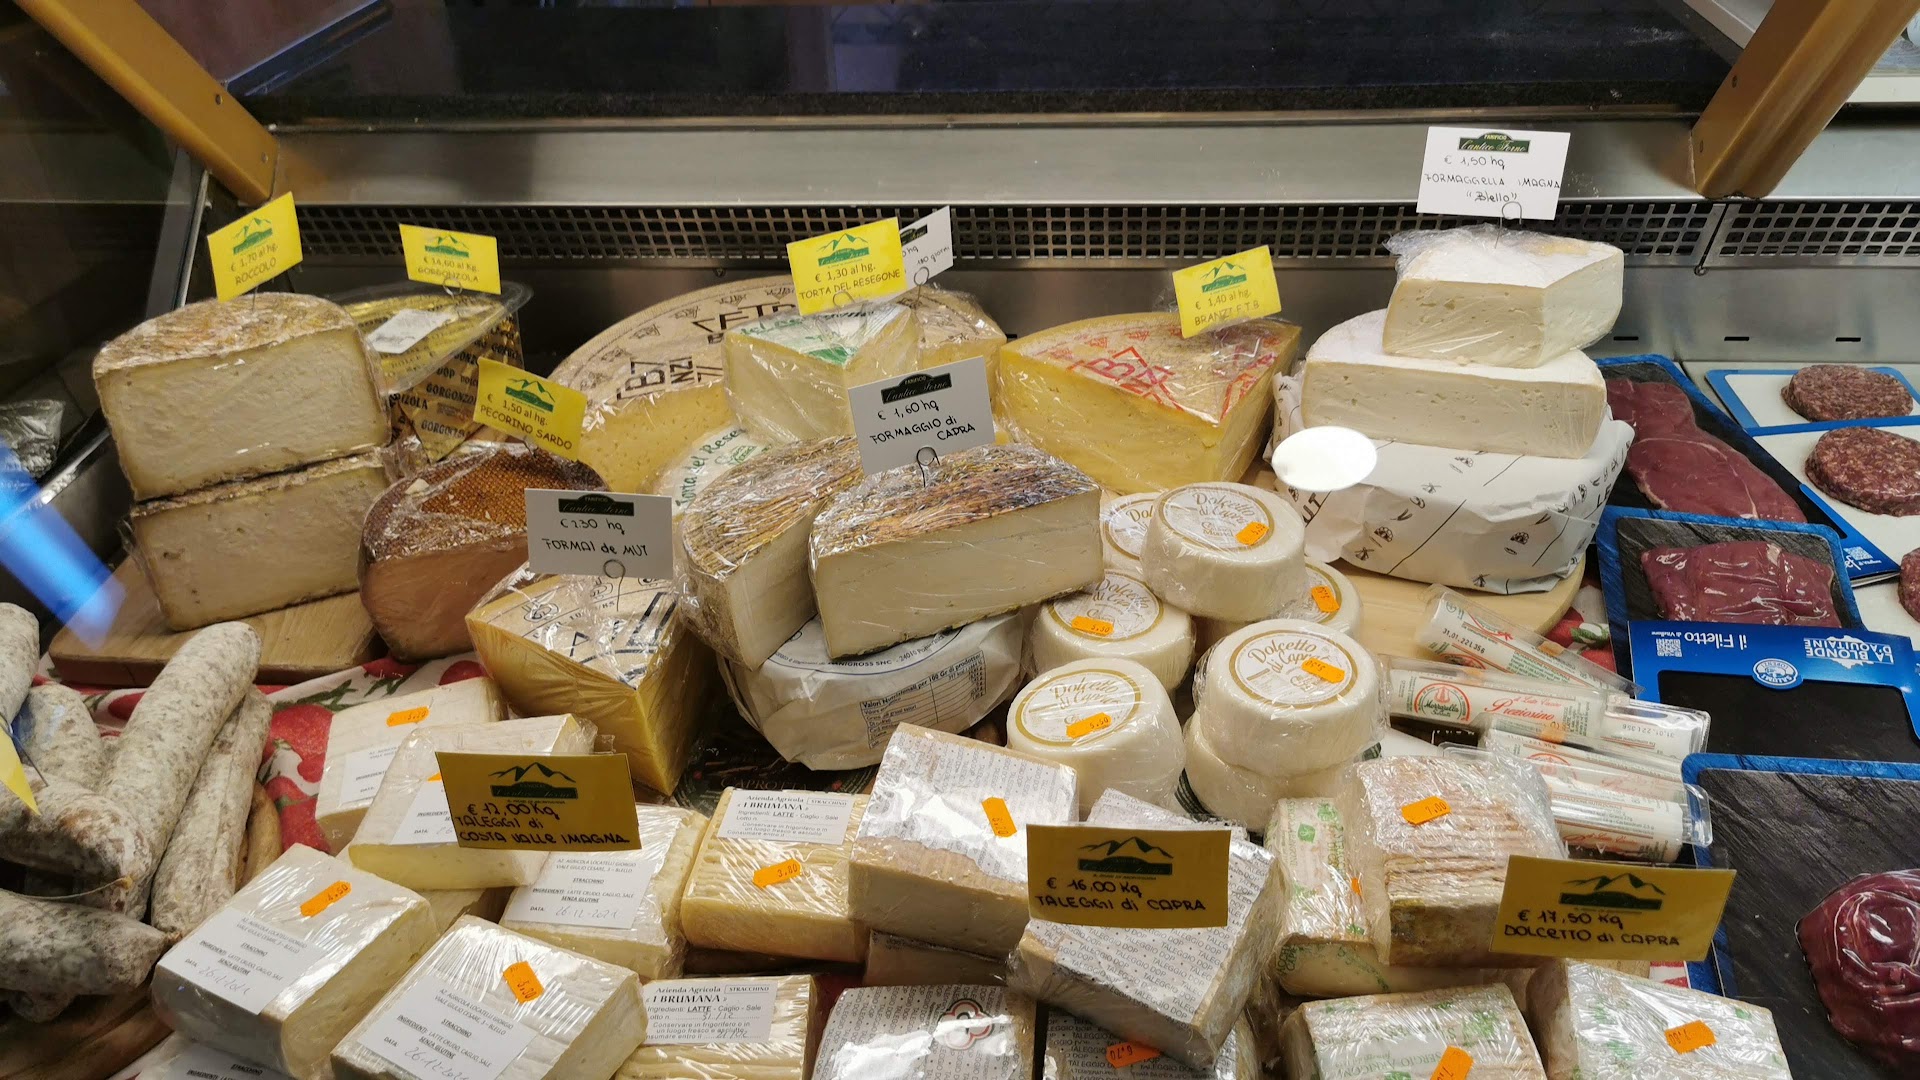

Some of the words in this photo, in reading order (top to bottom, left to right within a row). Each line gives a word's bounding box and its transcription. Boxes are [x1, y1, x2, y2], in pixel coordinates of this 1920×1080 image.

[1460, 156, 1487, 167] 1,50
[235, 257, 276, 286] ROCCOLO
[815, 274, 822, 283] €
[828, 269, 848, 281] 1,30
[850, 265, 860, 275] al
[799, 287, 831, 300] TORTA
[834, 283, 852, 294] DEL
[853, 269, 900, 288] RESEGONE
[1208, 295, 1227, 308] 1,40
[487, 393, 493, 403] €
[503, 400, 523, 415] 1,50
[524, 409, 532, 418] al
[894, 402, 920, 419] 1,60
[481, 405, 533, 434] PECORINO
[536, 429, 572, 450] SARDO
[870, 418, 941, 444] FORMAGGIO
[945, 415, 957, 426] di
[937, 423, 976, 441] CAPRA
[1192, 492, 1256, 517] Dolcetto
[542, 538, 596, 552] FORMAI
[601, 543, 617, 555] de
[1684, 632, 1735, 650] Filetto
[1738, 634, 1748, 650] il
[1804, 638, 1893, 654] D'AQUITAINE
[1248, 639, 1317, 664] Dolcetto
[1806, 648, 1869, 662] BLONDE
[1877, 651, 1894, 665] LA
[467, 803, 477, 816] €
[483, 803, 532, 817] 12,00
[533, 803, 560, 820] Kg
[749, 802, 803, 811] BRUMANA
[455, 815, 521, 828] TALEGGI
[528, 817, 544, 829] di
[460, 831, 507, 843] COSTA
[561, 833, 630, 845] IMAGNA
[1047, 877, 1057, 889] €
[1067, 879, 1116, 893] 16,00
[1121, 881, 1142, 898] Kg
[1035, 895, 1114, 910] TALEGGI
[1121, 897, 1139, 911] di
[1147, 898, 1206, 911] CAPRA
[1518, 909, 1528, 921] €
[1538, 910, 1592, 924] 17,50
[1597, 931, 1615, 943] di
[1621, 933, 1680, 947] CAPRA
[688, 986, 721, 994] Agricola
[660, 995, 720, 1003] BRUMANA
[1169, 1006, 1188, 1019] DOP
